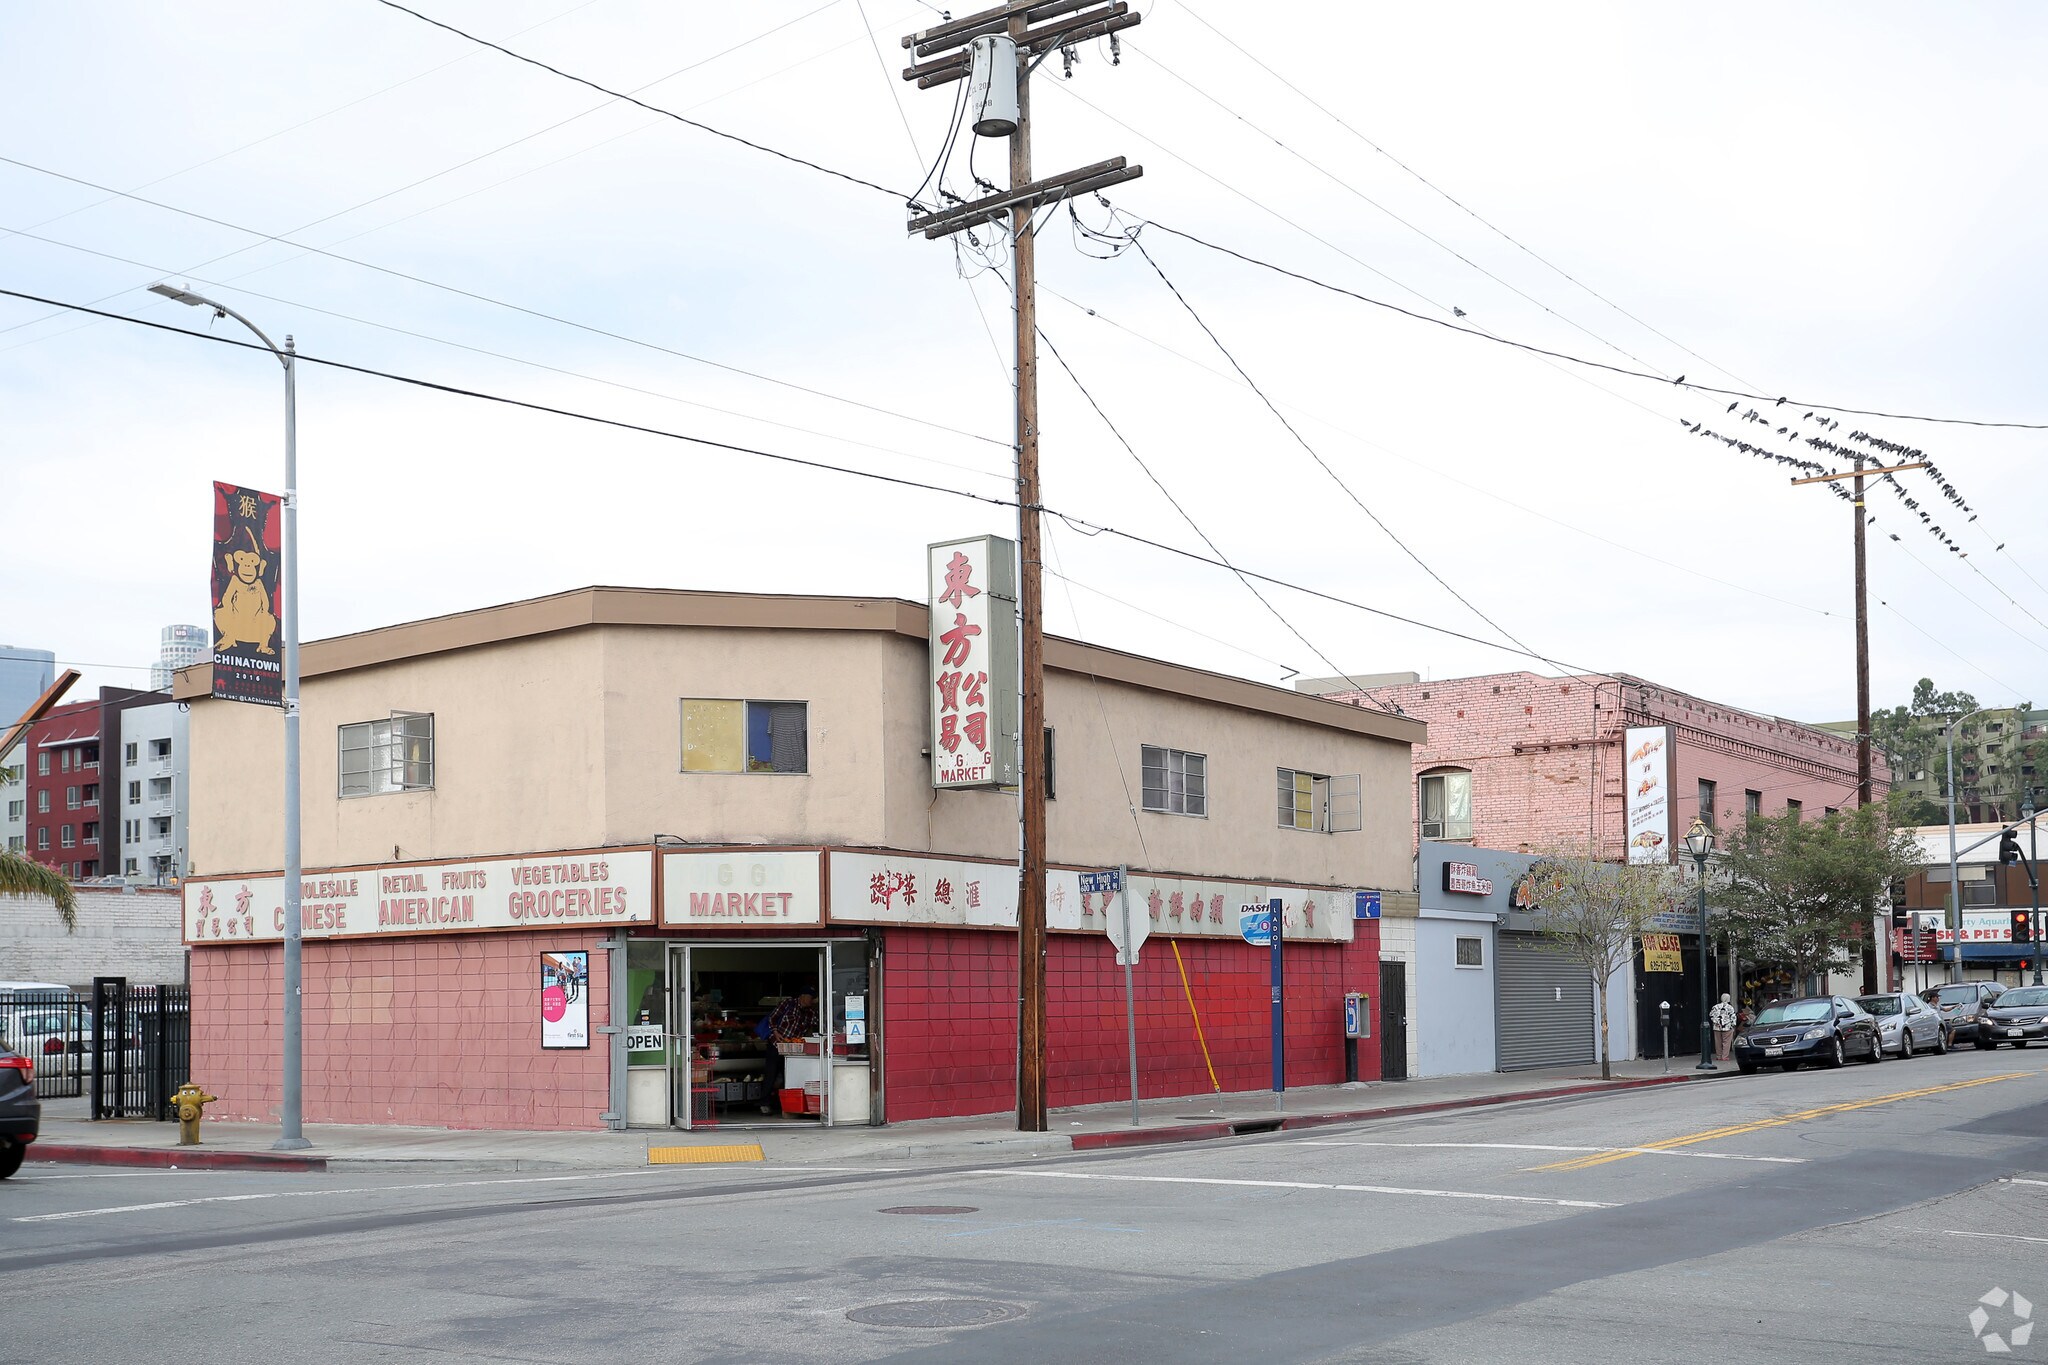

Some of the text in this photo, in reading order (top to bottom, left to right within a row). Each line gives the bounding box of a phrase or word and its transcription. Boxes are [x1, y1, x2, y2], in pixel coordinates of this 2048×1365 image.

[239, 495, 257, 520] 猴
[938, 551, 982, 668] 東方
[214, 653, 279, 672] CHINATOWN
[236, 672, 260, 682] 2016
[941, 766, 986, 783] MARKET
[382, 870, 486, 894] RETAIL FRUITS
[511, 861, 609, 886] VEGETABLES
[1080, 875, 1094, 886] New
[1097, 873, 1111, 887] High
[378, 895, 474, 926] AMERICAN
[508, 886, 627, 919] GROCERIES
[689, 892, 793, 917] MARKET
[1240, 904, 1270, 913] DASH
[274, 903, 346, 931] CNESE
[1643, 934, 1681, 952] FOR LEASE
[1959, 930, 1969, 939] &
[1973, 929, 1999, 939] PET
[850, 1023, 862, 1036] A
[627, 1034, 662, 1050] OPEN
